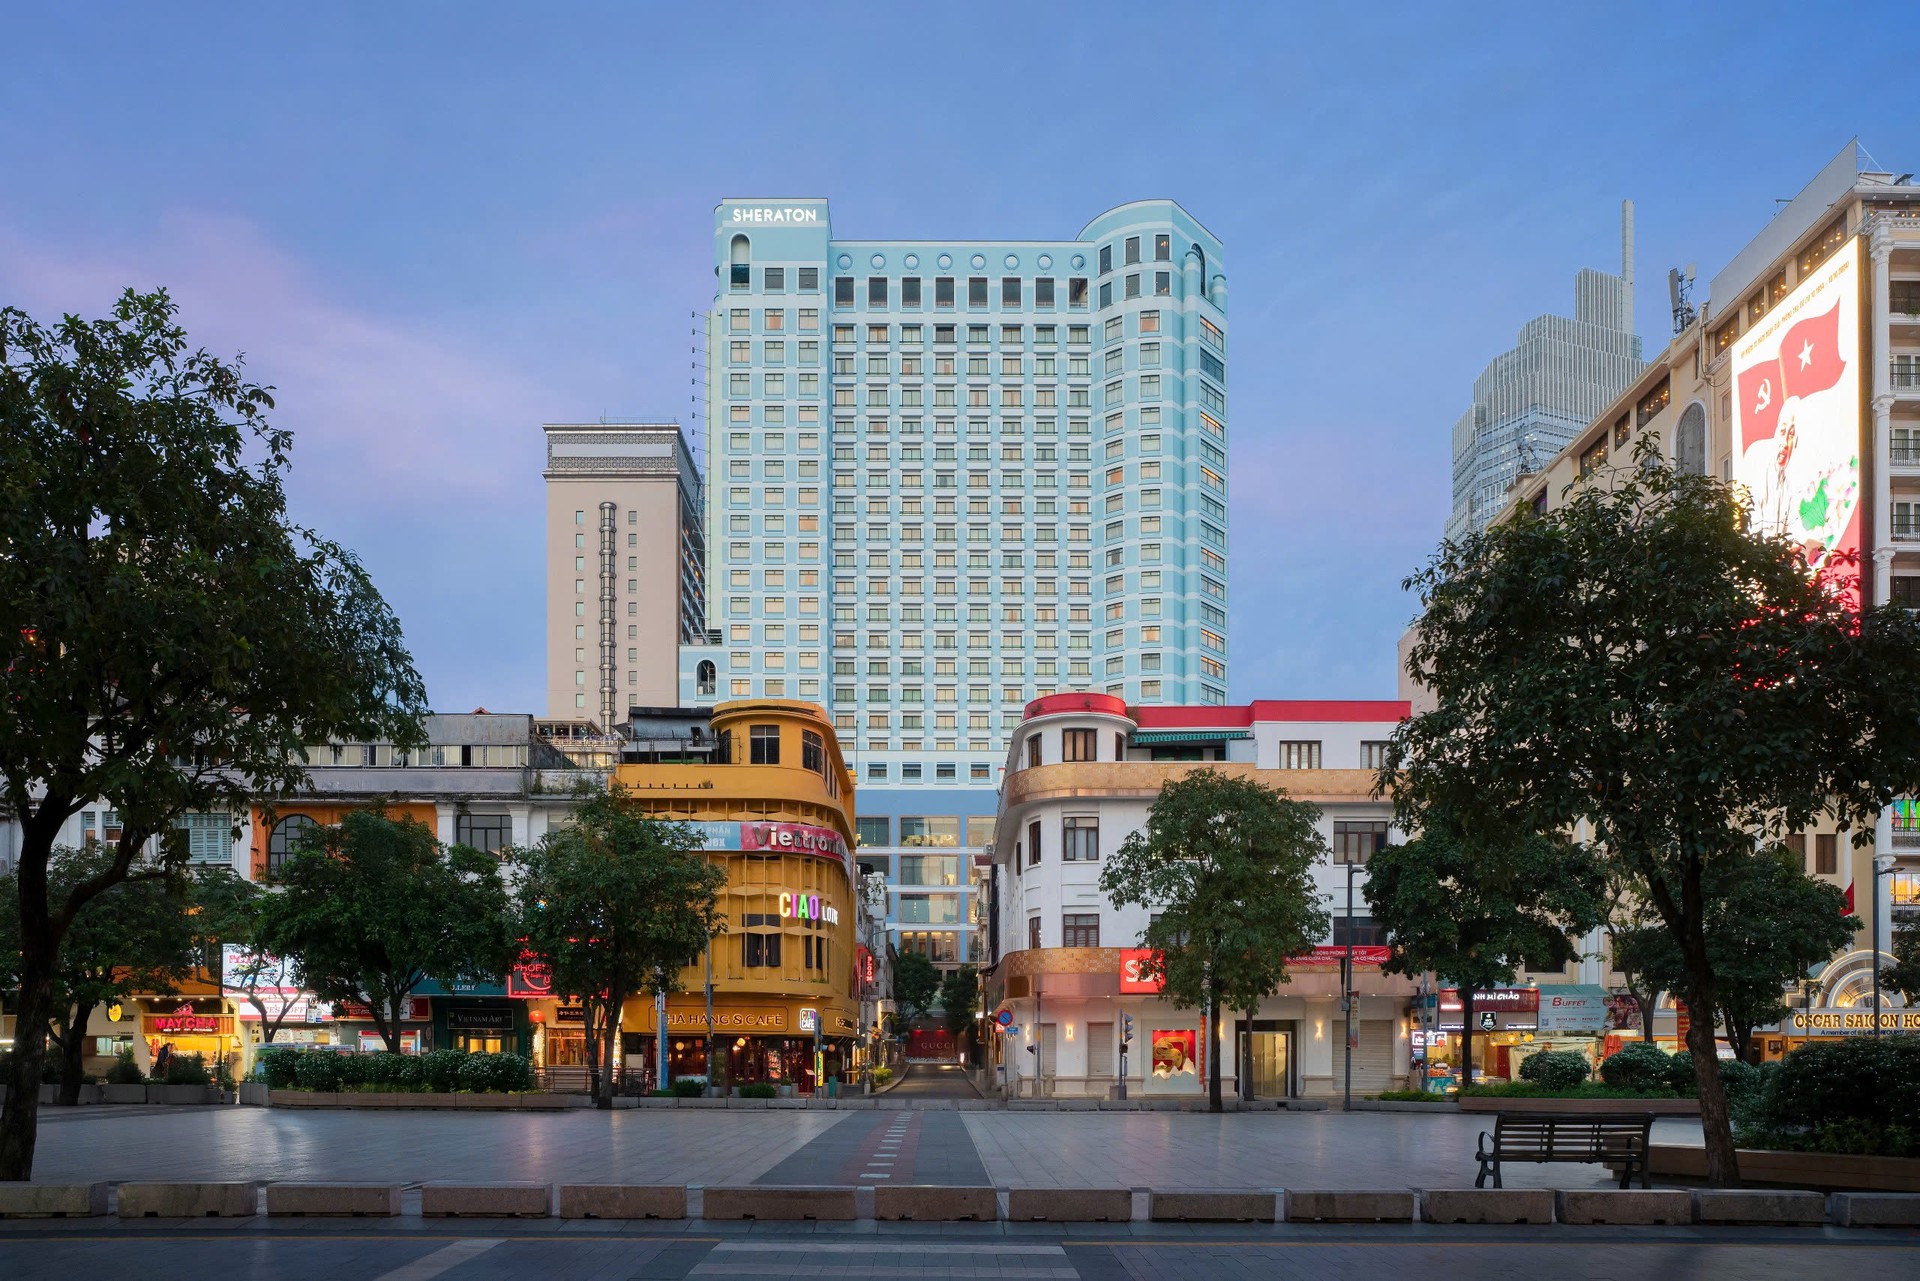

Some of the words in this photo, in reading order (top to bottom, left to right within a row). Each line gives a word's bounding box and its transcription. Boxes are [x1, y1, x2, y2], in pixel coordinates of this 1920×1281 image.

[732, 208, 817, 222] SHERATON
[779, 892, 819, 920] CIAO
[1552, 997, 1587, 1007] BUFFET
[155, 1017, 183, 1029] MAY
[185, 1017, 217, 1029] CHA
[457, 1014, 488, 1023] VIETNAM
[666, 1012, 686, 1025] HÀ
[689, 1012, 730, 1026] HÀNG
[732, 1013, 743, 1026] &
[745, 1012, 784, 1026] CAFÉ
[1794, 1013, 1841, 1029] OSCAR
[921, 1042, 954, 1050] GUCCI
